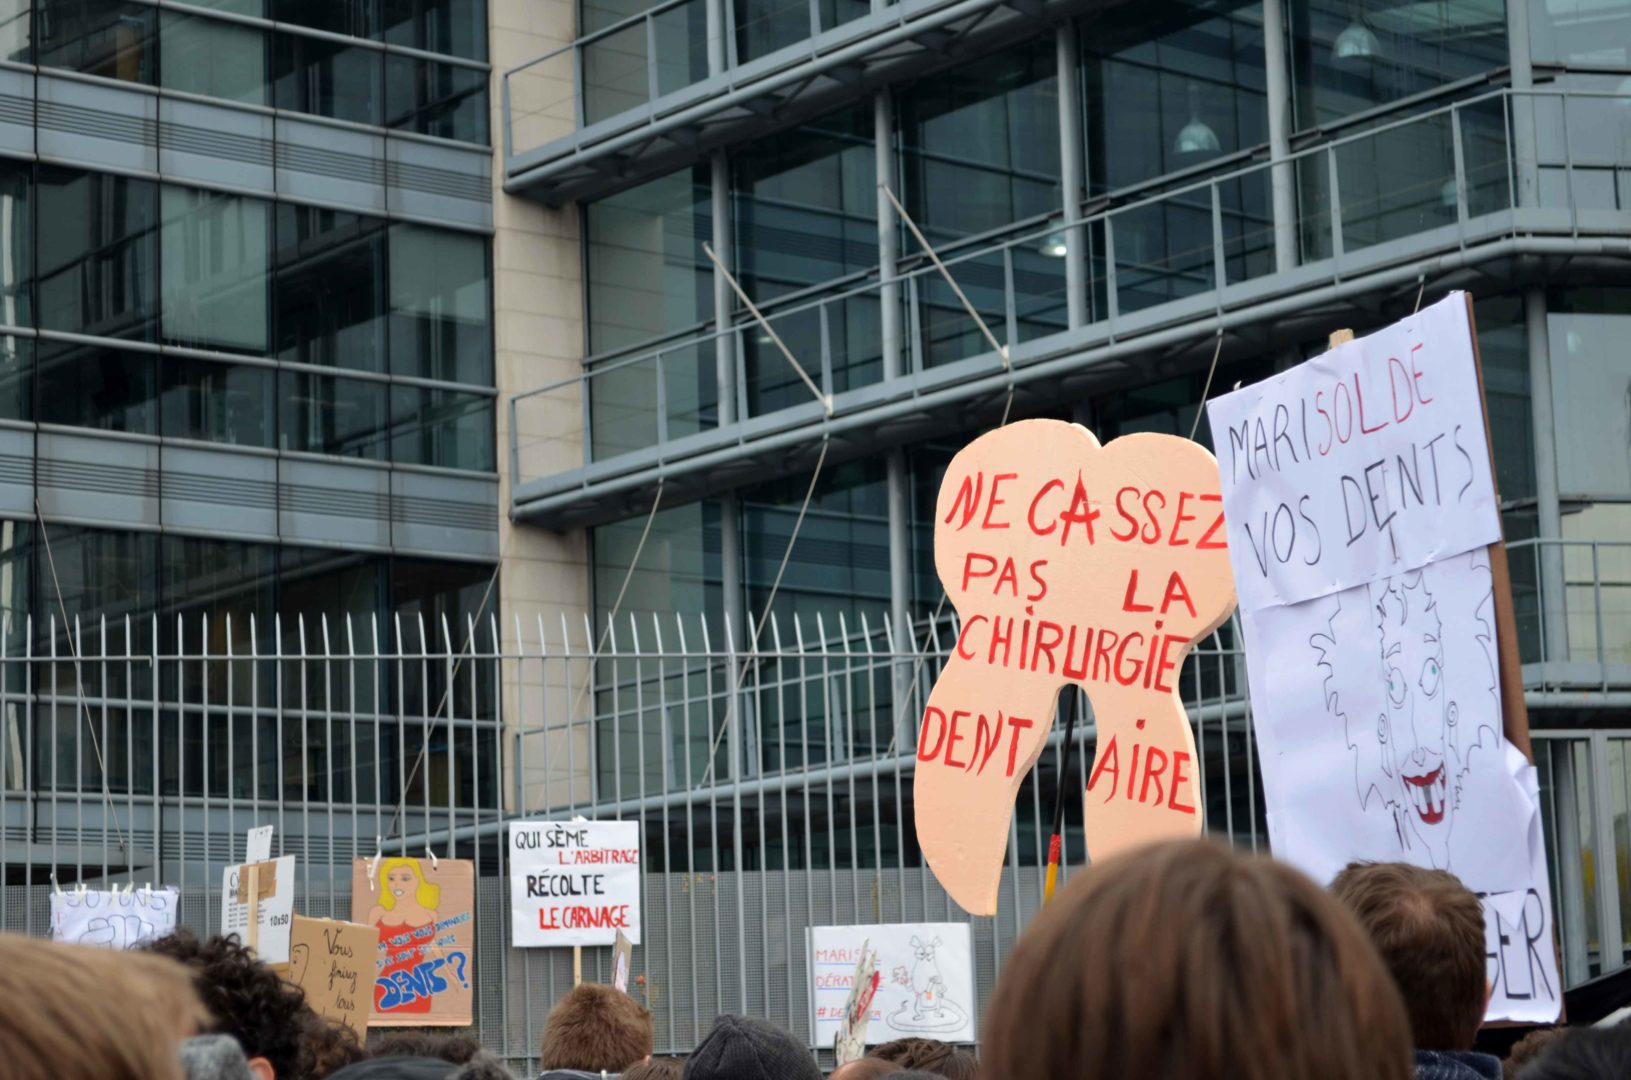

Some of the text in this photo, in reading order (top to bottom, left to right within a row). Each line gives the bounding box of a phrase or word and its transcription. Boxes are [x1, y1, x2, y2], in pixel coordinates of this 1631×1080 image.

[945, 467, 1229, 550] NE CASSEZ
[1244, 424, 1474, 578] VOS DENTS
[961, 552, 1197, 618] PAS LA
[957, 605, 1192, 693] CHIRURGIE
[917, 705, 1196, 814] DENT AIRE
[515, 823, 589, 850] QUI SÈME
[526, 867, 605, 898] RÉCOLTE
[324, 928, 353, 958] Vous
[538, 904, 630, 929] LE CARNAGE
